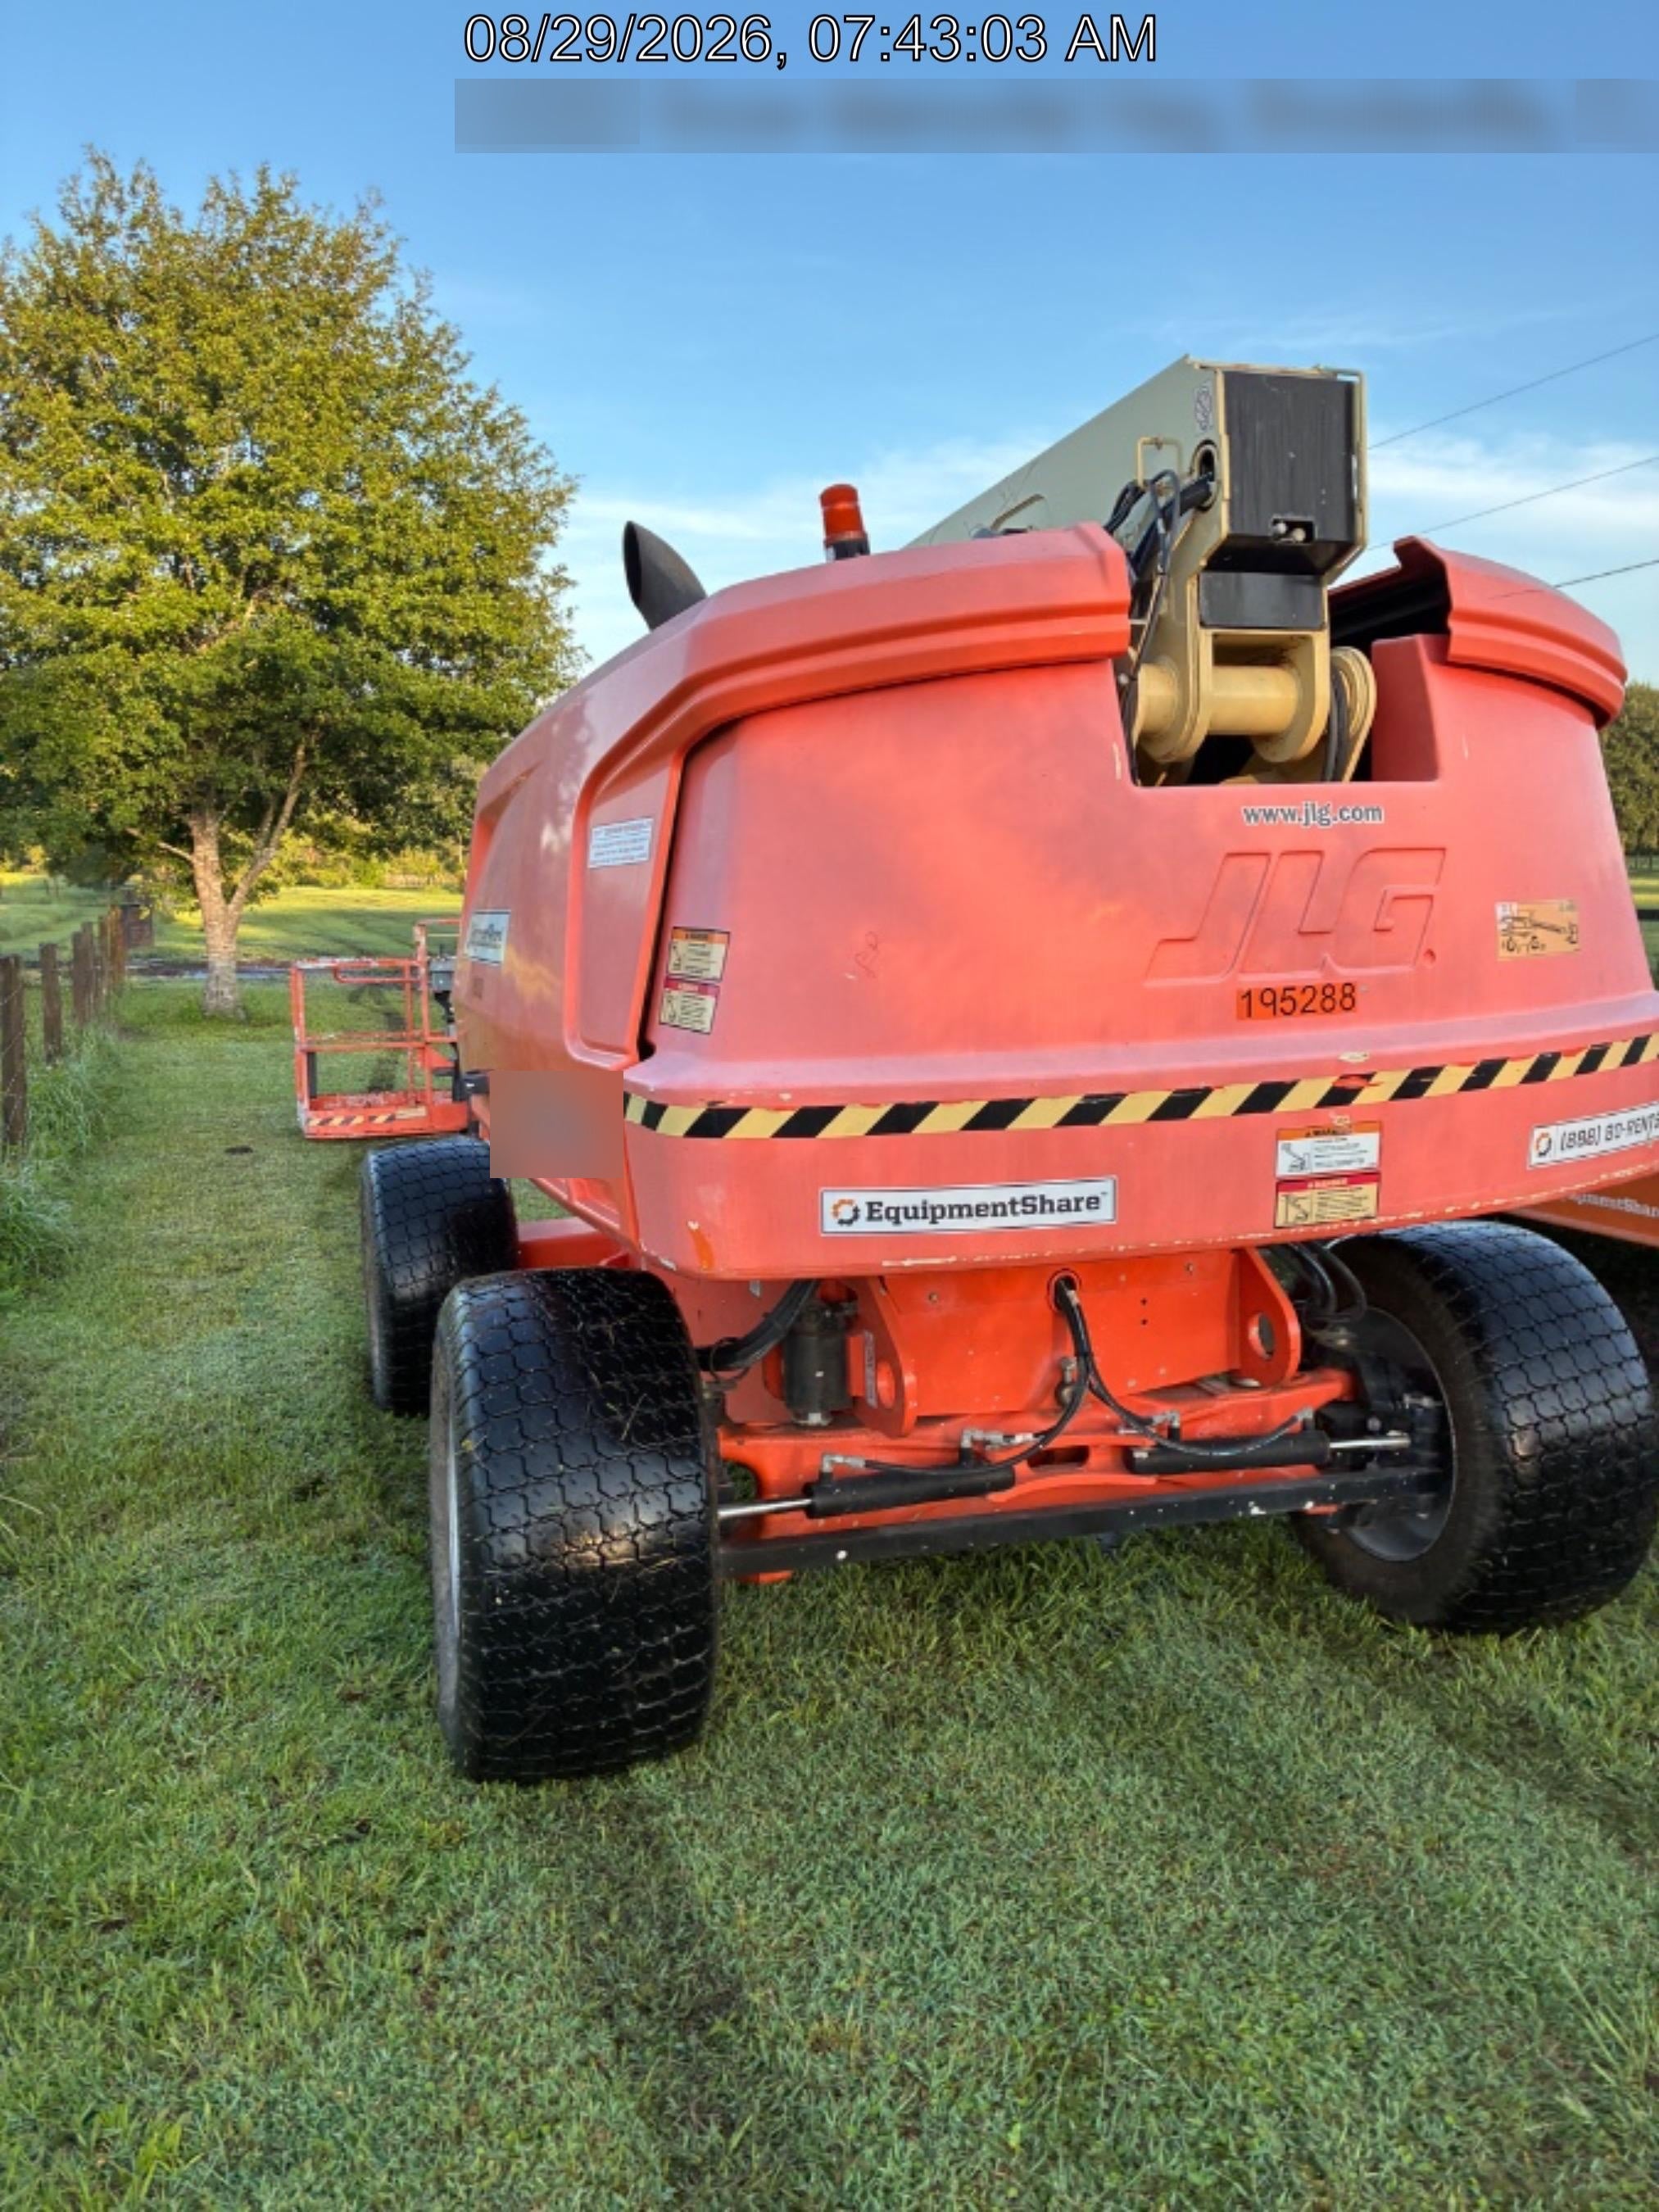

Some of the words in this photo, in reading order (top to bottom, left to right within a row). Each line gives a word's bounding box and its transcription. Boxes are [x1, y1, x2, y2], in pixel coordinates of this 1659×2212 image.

[1243, 802, 1383, 827] www.jlg.com
[1144, 847, 1446, 986] JLG
[1240, 982, 1356, 1018] 195288
[865, 1193, 1101, 1226] EquipmentShare
